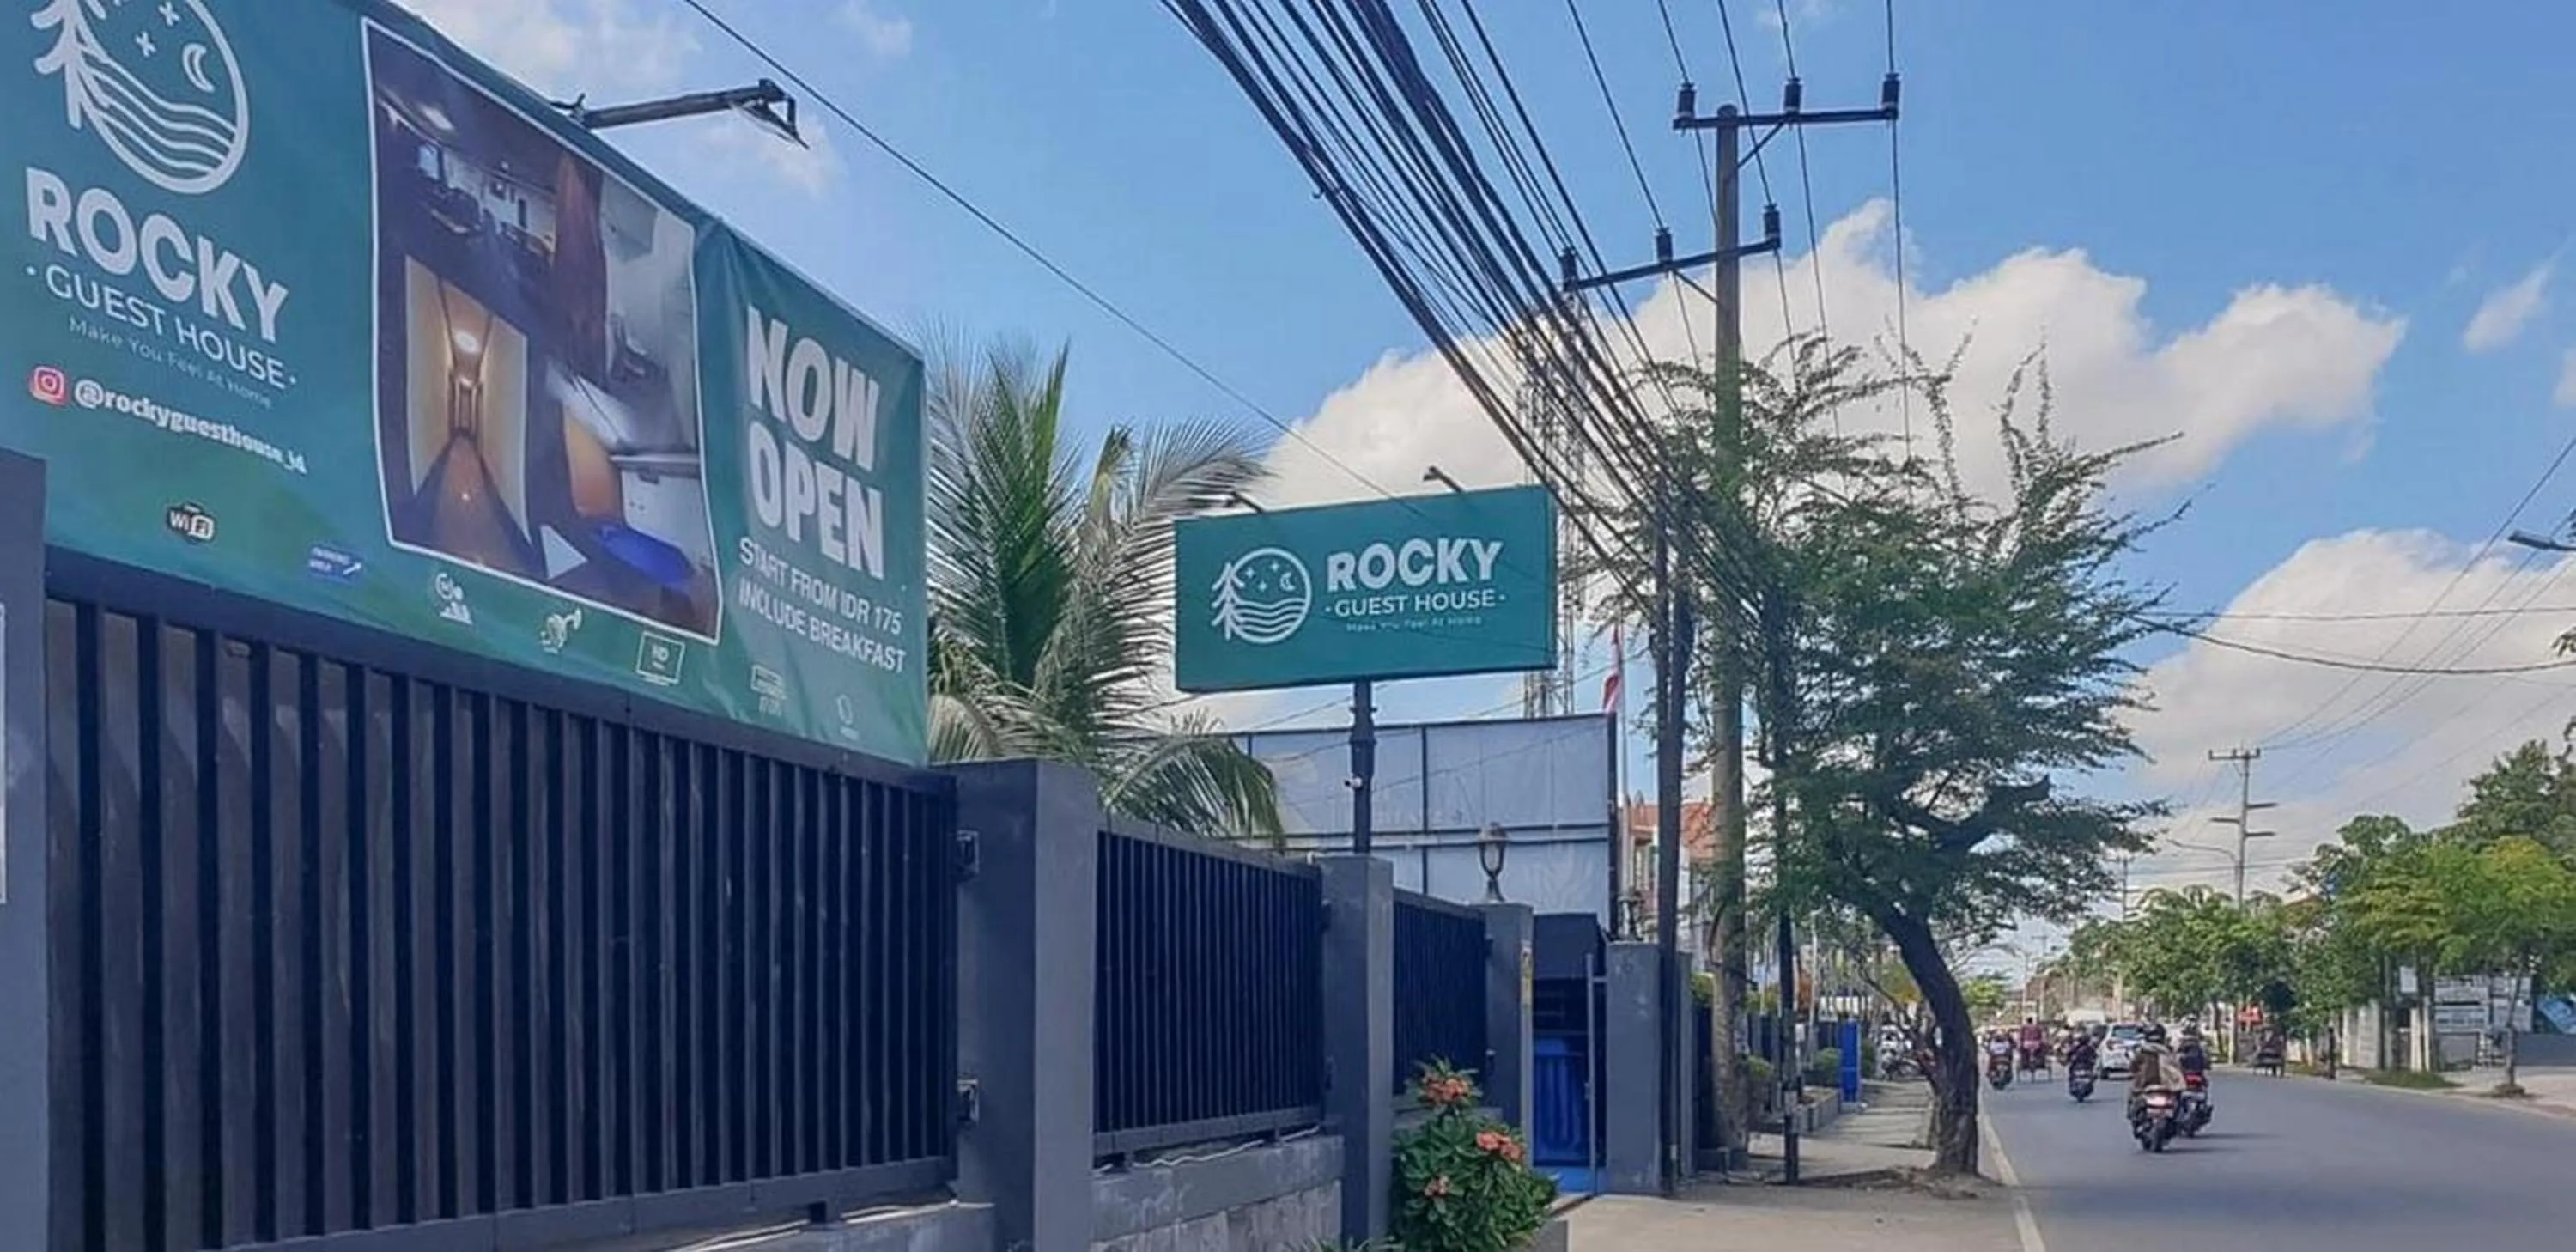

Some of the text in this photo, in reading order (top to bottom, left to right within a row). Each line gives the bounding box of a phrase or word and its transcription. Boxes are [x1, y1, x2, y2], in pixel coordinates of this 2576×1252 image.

[26, 167, 289, 343] ROCKY
[45, 264, 286, 389] GUEST HOUSE
[69, 316, 124, 349] Make
[129, 337, 162, 362] You
[748, 304, 880, 471] NOW
[749, 422, 884, 581] OPEN
[739, 537, 902, 635] START FROM IDR 175
[1327, 538, 1504, 593] ROCKY
[1334, 588, 1497, 617] GUEST HOUSE
[738, 578, 907, 673] INCLUDE BREAKFAST
